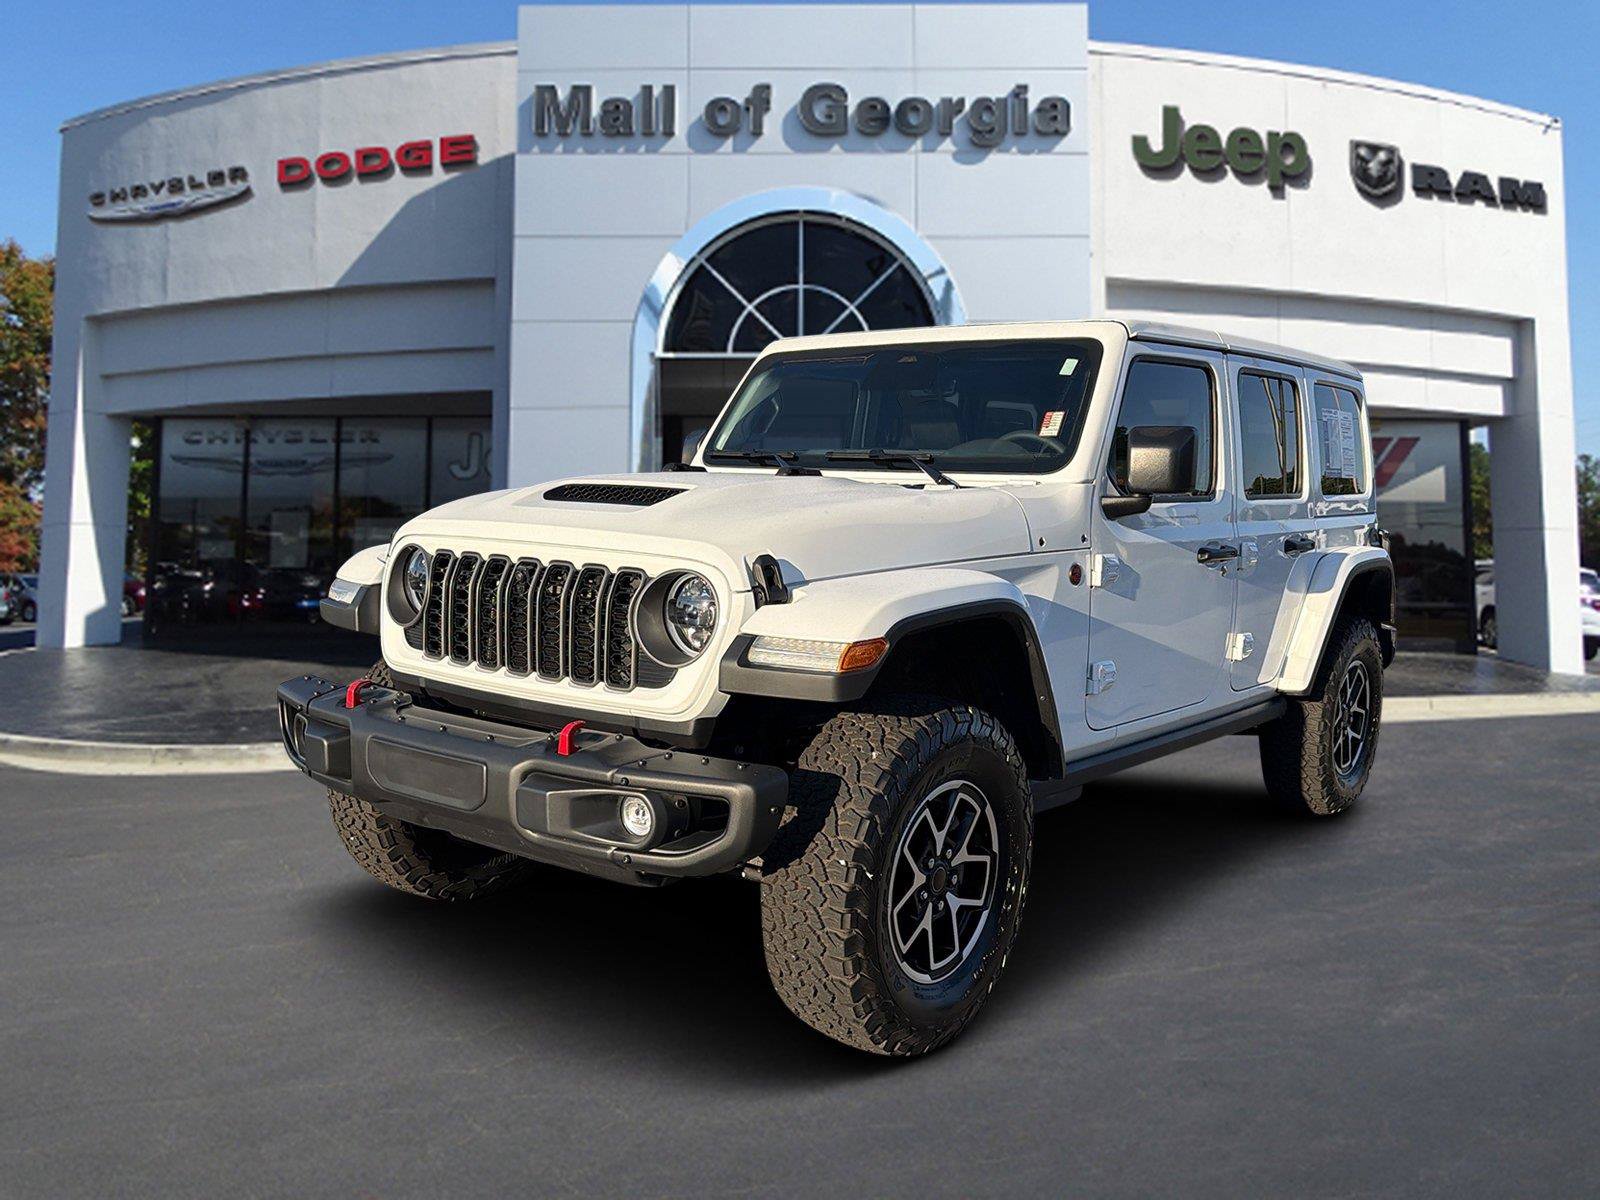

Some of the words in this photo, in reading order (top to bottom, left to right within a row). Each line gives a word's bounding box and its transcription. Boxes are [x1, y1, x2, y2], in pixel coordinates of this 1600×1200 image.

[531, 84, 677, 137] Mall
[704, 84, 772, 137] of
[799, 83, 1073, 147] Georgia
[277, 134, 478, 187] DODGE
[1131, 105, 1309, 193] Jeep
[89, 166, 249, 206] CHRYSLER
[1411, 163, 1547, 212] RAM
